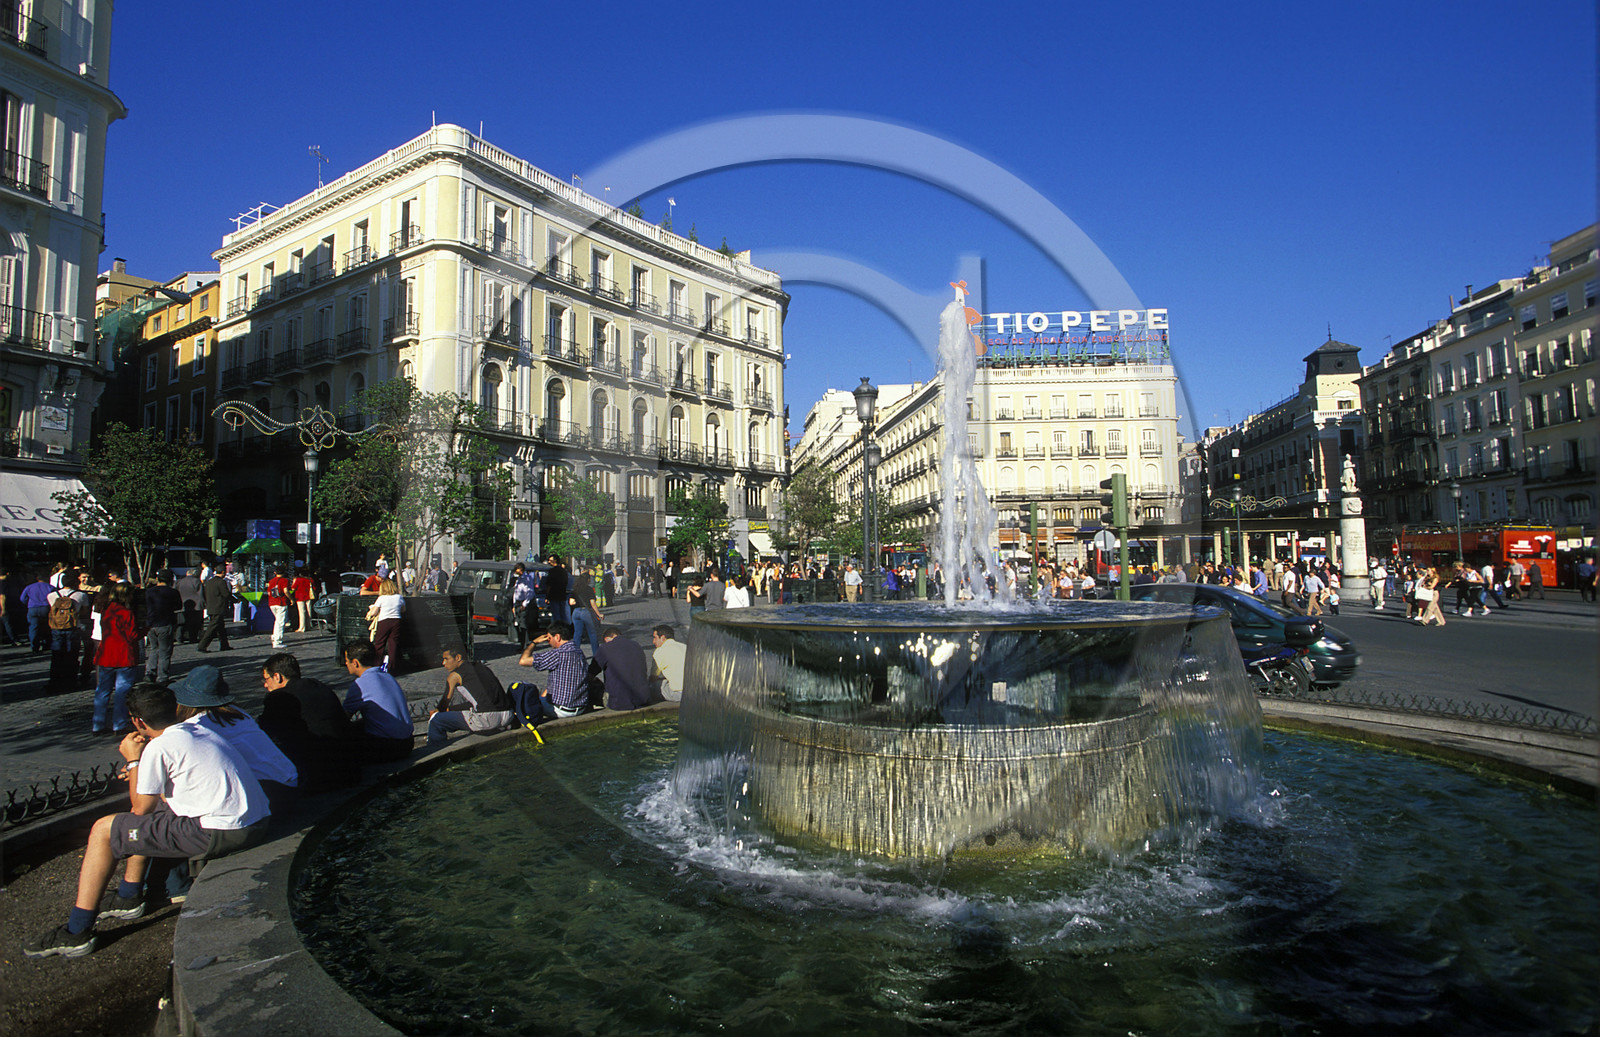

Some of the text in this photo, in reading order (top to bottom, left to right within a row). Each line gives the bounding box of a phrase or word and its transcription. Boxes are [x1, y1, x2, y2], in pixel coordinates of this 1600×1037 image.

[989, 308, 1169, 334] TIO PEPE
[988, 333, 1168, 346] SOL DE ANDALUCIA EMBOTELLADO
[991, 341, 1170, 362] GONZALEZ BYASS
